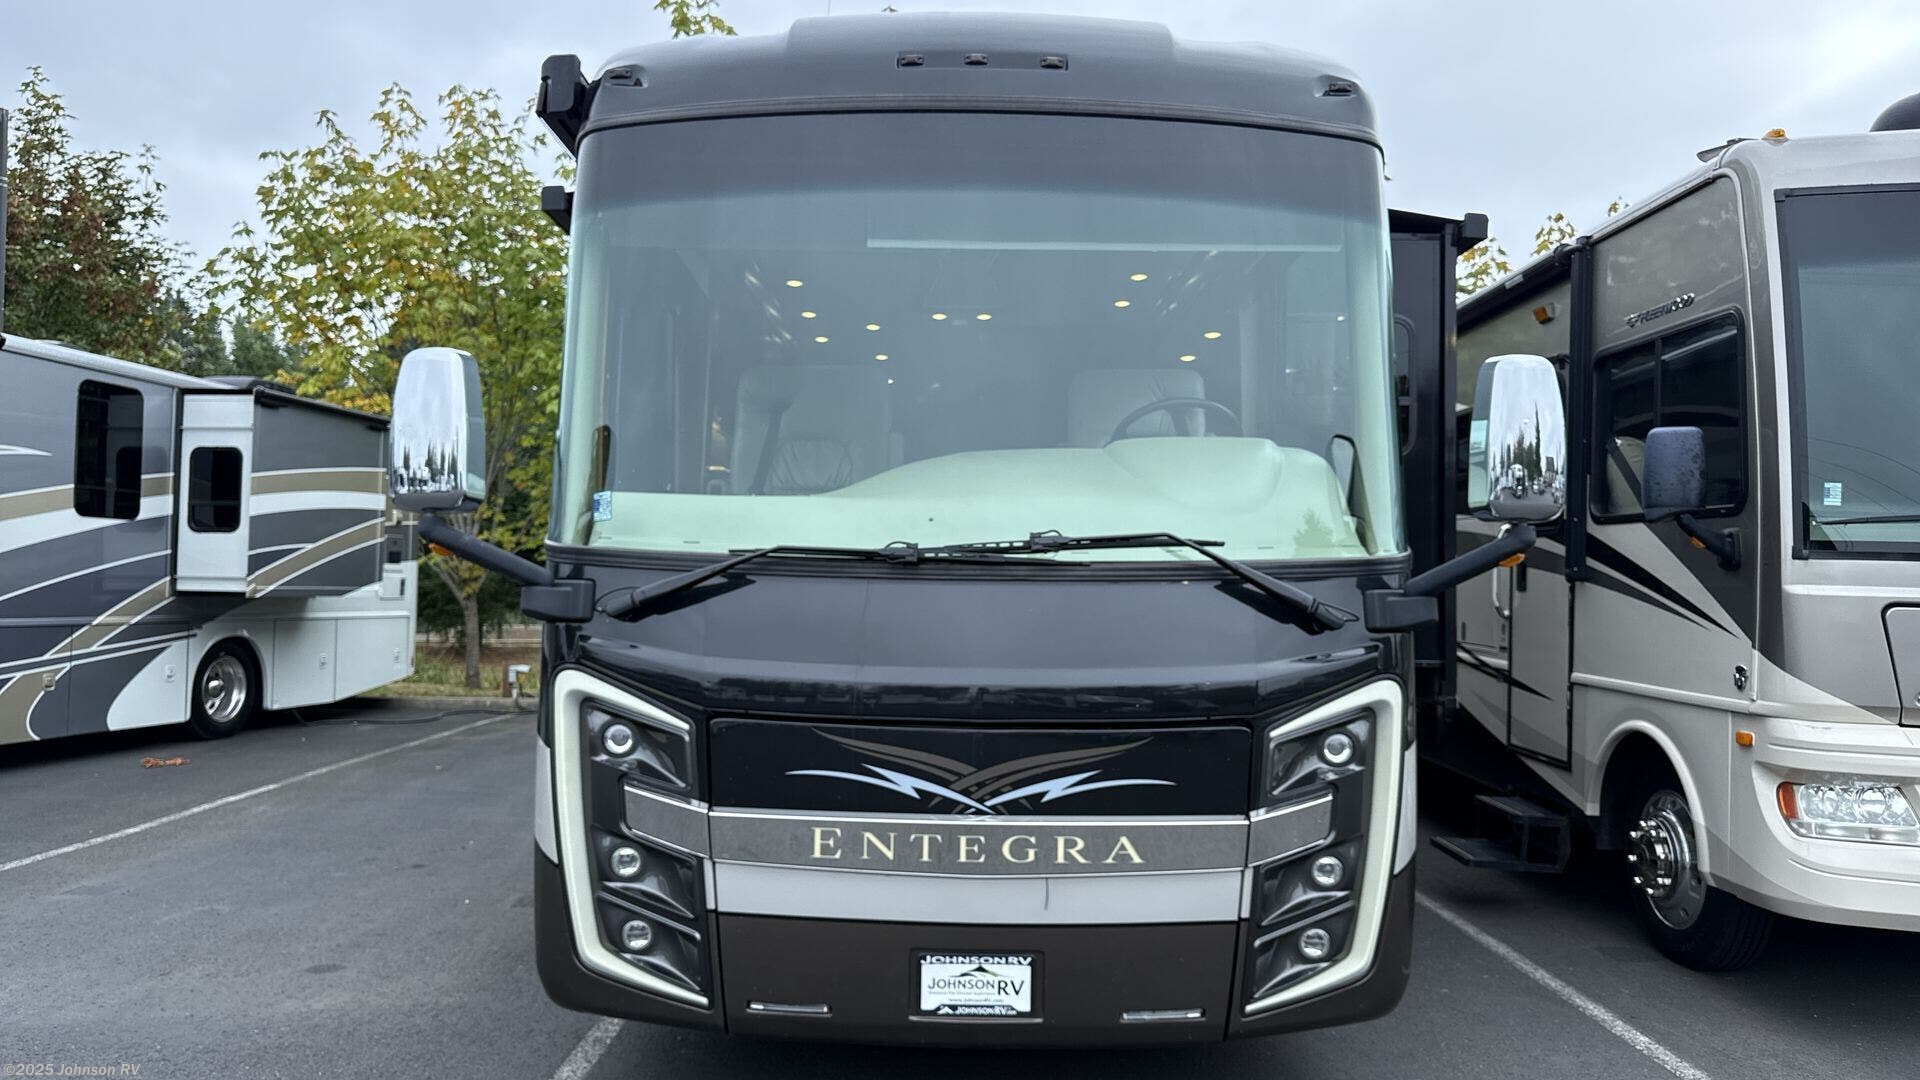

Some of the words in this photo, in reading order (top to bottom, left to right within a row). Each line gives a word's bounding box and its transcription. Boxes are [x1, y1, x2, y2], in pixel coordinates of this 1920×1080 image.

[811, 826, 1145, 864] ENTEGRA
[928, 978, 995, 990] JOHNSON
[998, 980, 1025, 995] RV
